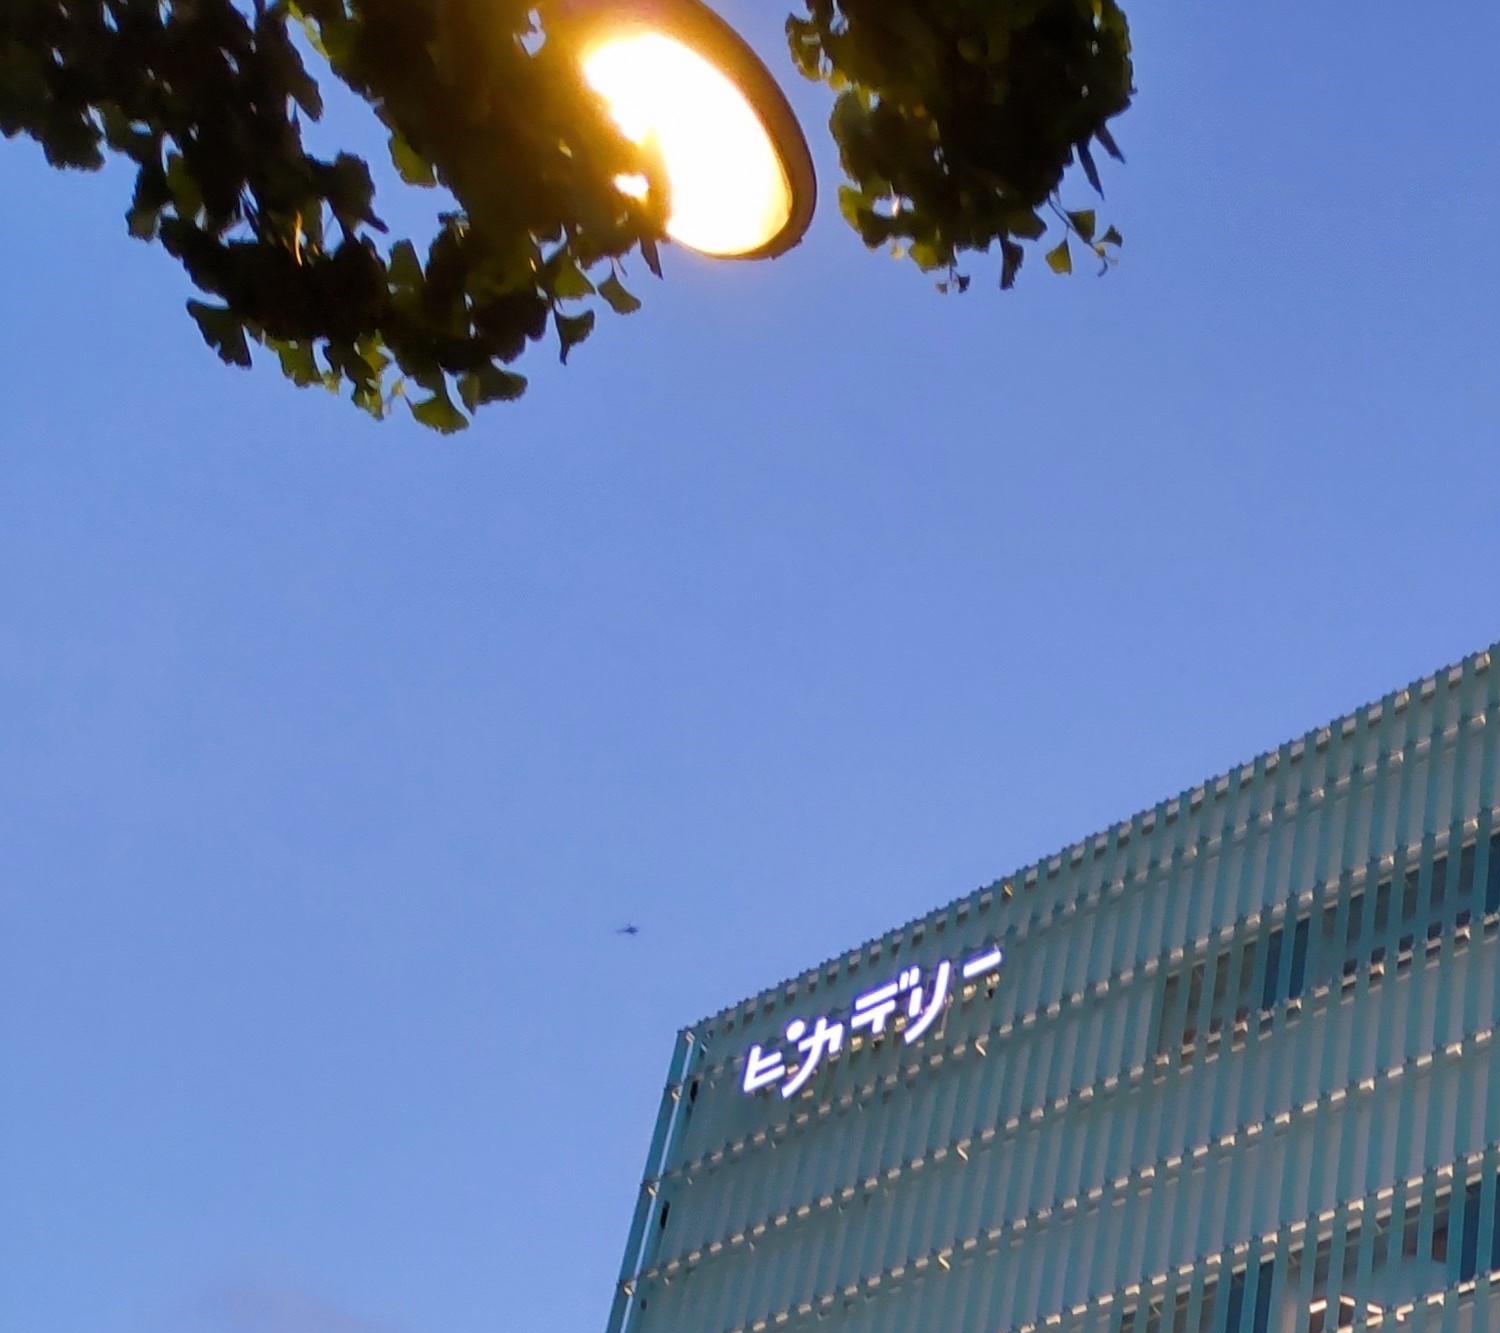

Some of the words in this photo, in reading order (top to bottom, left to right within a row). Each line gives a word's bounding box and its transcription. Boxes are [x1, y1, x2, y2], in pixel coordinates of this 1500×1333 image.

[743, 950, 1001, 1099] ピカデリー
